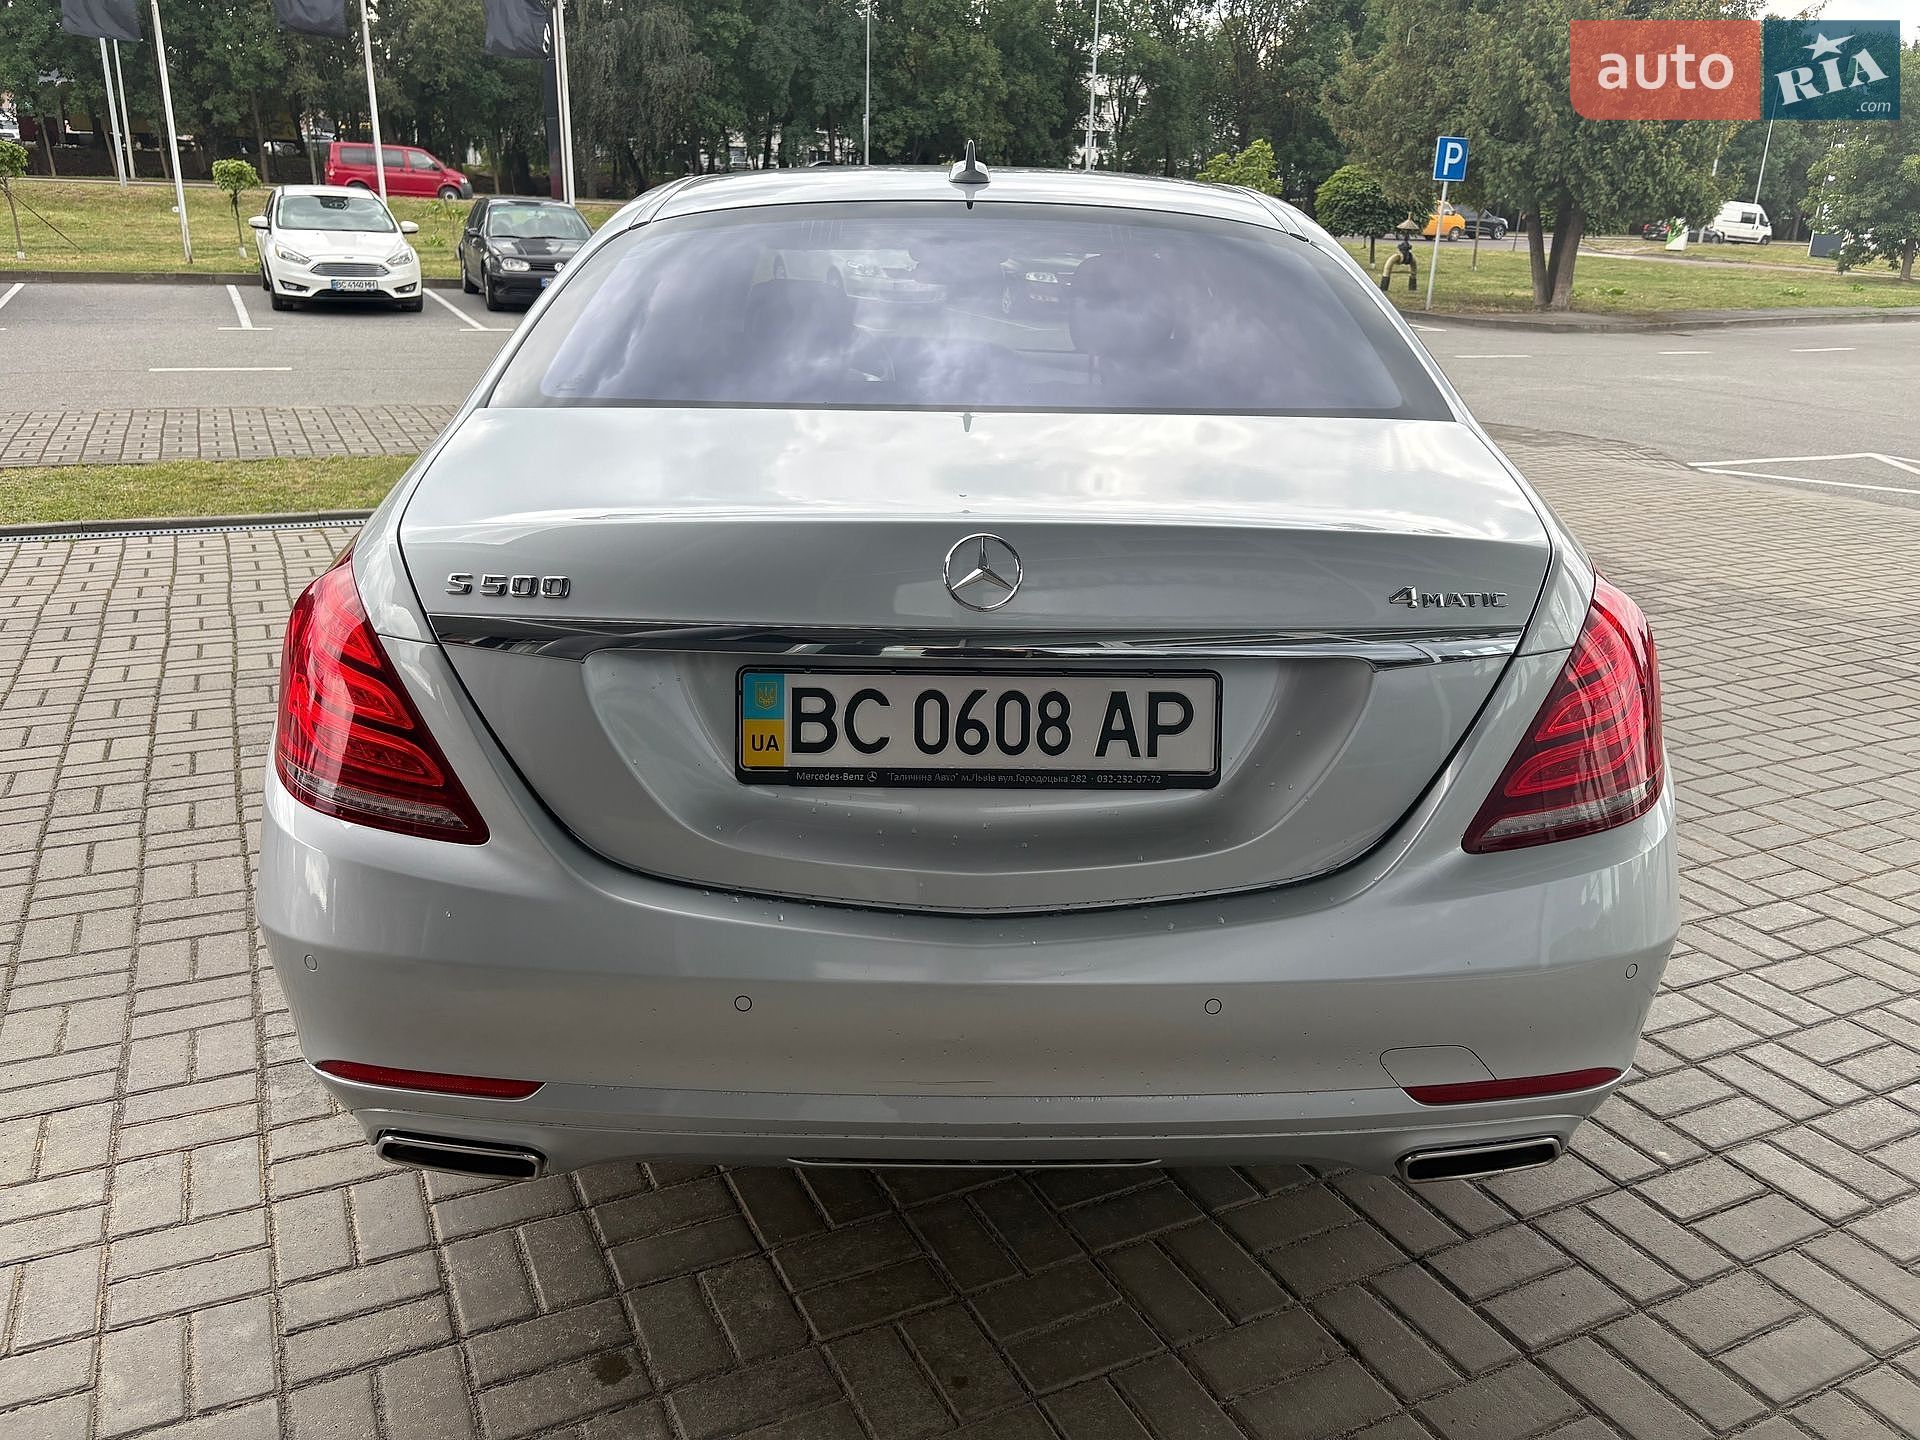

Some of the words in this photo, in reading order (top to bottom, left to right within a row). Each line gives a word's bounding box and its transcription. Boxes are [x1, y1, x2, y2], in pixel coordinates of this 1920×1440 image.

[1443, 142, 1463, 175] P
[444, 573, 474, 595] S
[480, 573, 571, 599] 500
[1388, 586, 1509, 608] 4MATIC
[791, 687, 891, 754] BC
[914, 689, 1072, 756] 0608
[1094, 691, 1195, 758] AP
[751, 734, 780, 752] UA
[796, 772, 865, 781] Mercedes-Benz
[1070, 774, 1087, 783] 282
